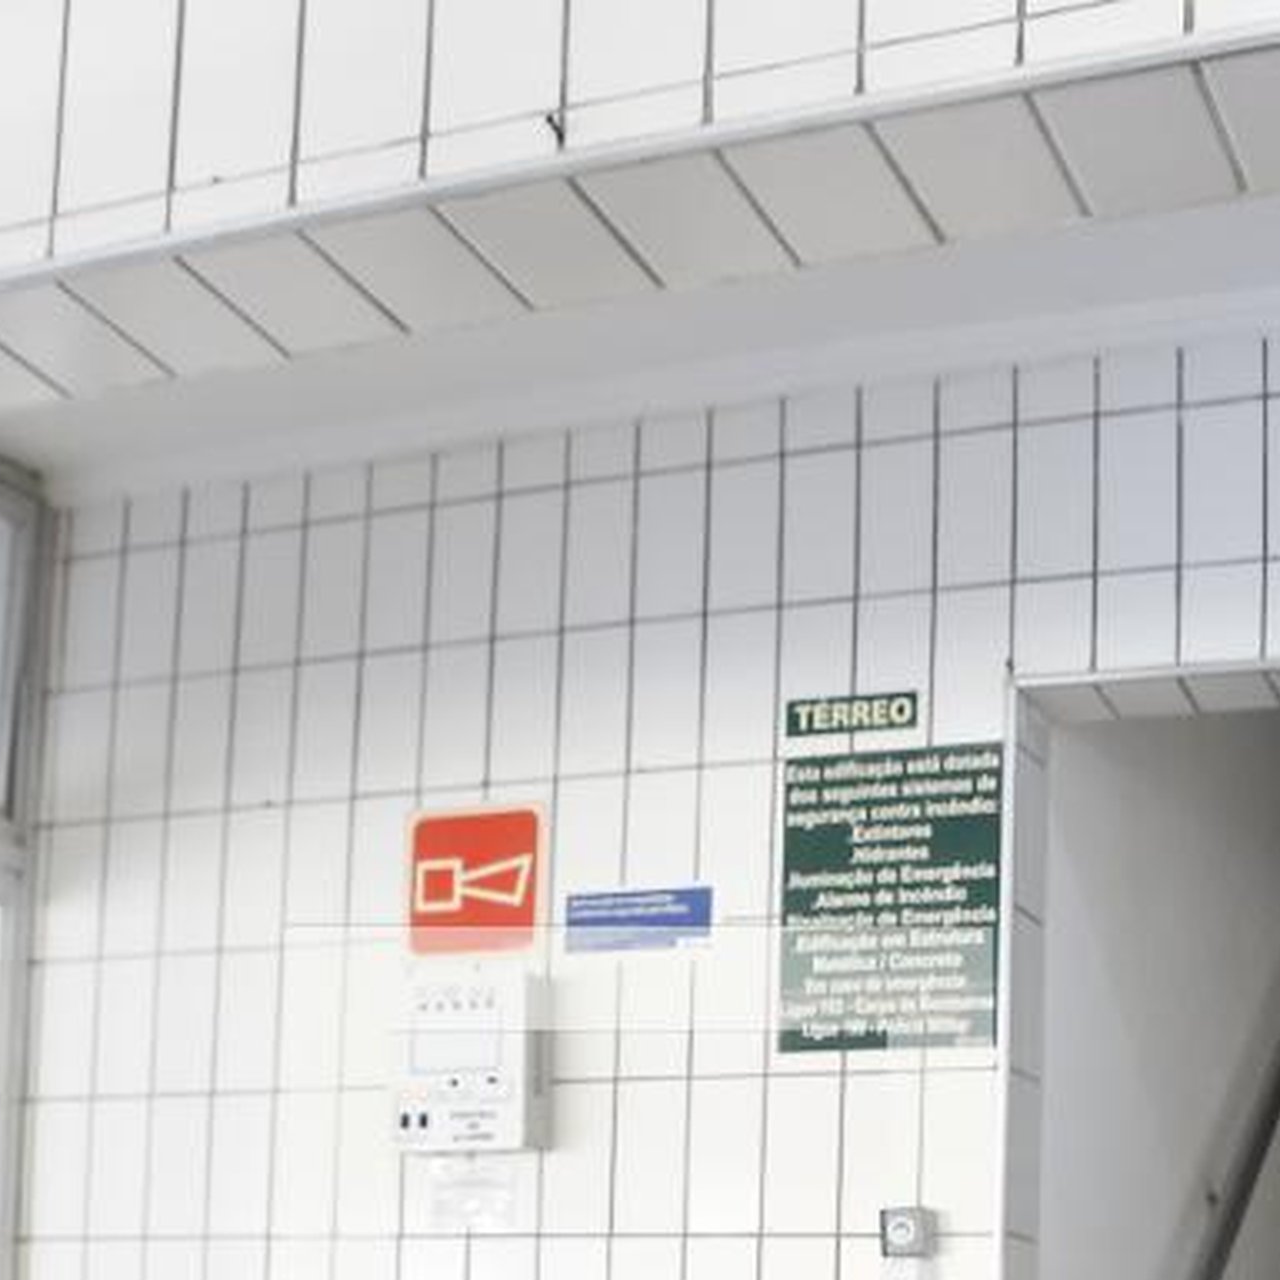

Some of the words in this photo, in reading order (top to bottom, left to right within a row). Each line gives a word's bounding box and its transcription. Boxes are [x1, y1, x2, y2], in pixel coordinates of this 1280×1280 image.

[787, 765, 820, 783] Esta
[822, 759, 903, 784] edificação
[906, 757, 940, 775] está
[943, 753, 999, 773] dotada
[789, 789, 817, 805] dos
[821, 783, 897, 807] seguintes
[901, 779, 973, 797] sistemas
[976, 775, 997, 792] de
[787, 809, 868, 831] segurança
[870, 804, 920, 820] contra
[852, 824, 933, 843] Extintores
[851, 846, 930, 865] Hidrantes
[788, 869, 873, 890] Iluminação
[876, 867, 897, 884] de
[900, 861, 997, 885] Emergência
[815, 891, 871, 908] Alarme
[874, 889, 895, 905] de
[898, 886, 968, 904] Incêndio
[876, 910, 898, 927] de
[901, 906, 998, 929] Emergência
[796, 932, 877, 954] Edificação
[880, 934, 907, 950] em
[909, 928, 985, 947] Estrutura
[889, 951, 964, 970] Concreto
